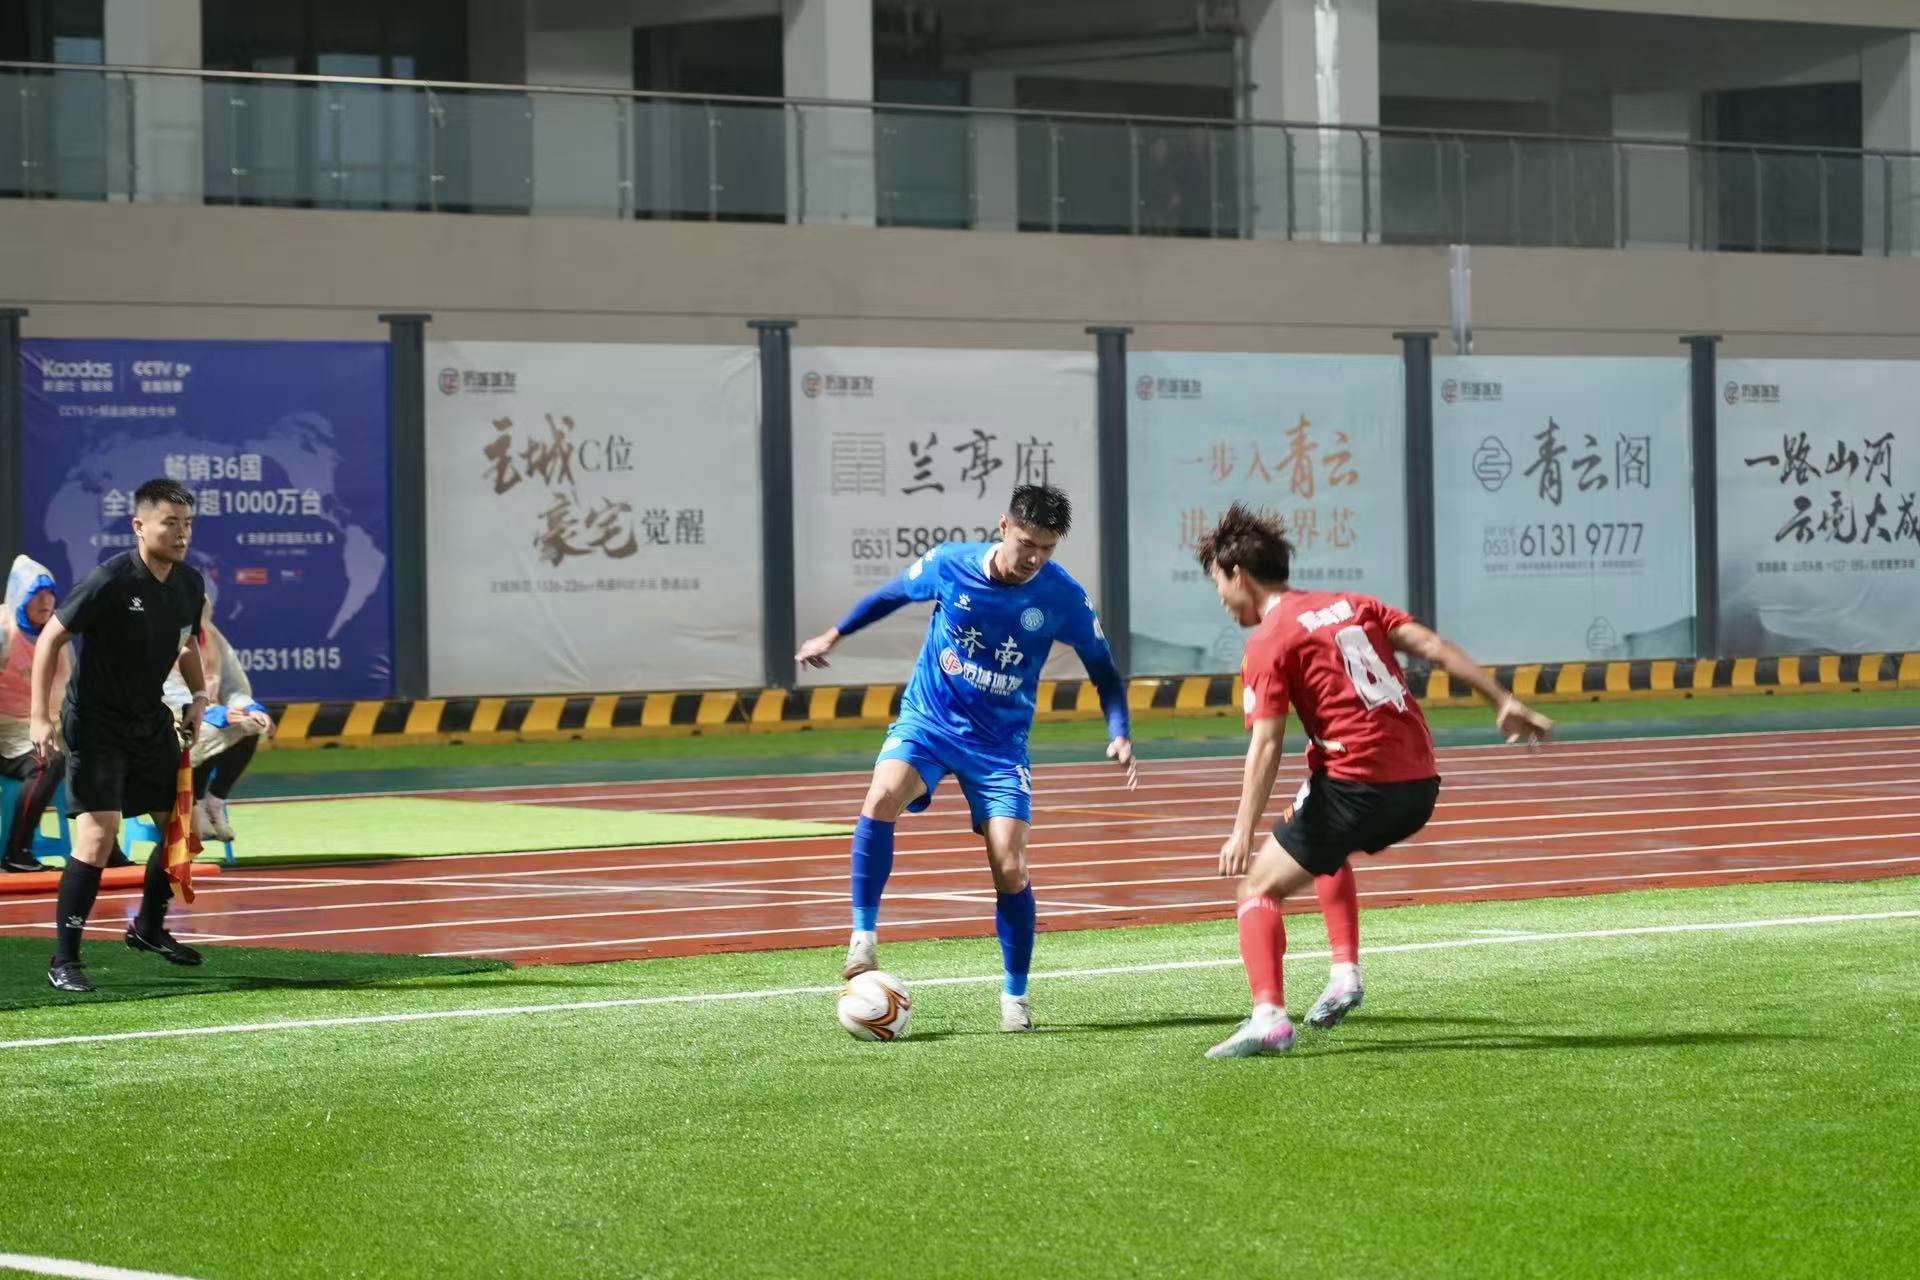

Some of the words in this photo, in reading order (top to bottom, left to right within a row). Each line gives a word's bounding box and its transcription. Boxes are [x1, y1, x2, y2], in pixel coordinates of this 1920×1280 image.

[164, 454, 262, 482] 畅销36国
[902, 429, 1053, 499] 兰亭府
[1525, 416, 1652, 506] 青云阁
[1744, 431, 1895, 487] 一路山河
[103, 488, 322, 517] 全超1000万台
[1519, 524, 1576, 557] 6131
[1586, 523, 1644, 556] 9777
[953, 626, 1024, 671] 济南
